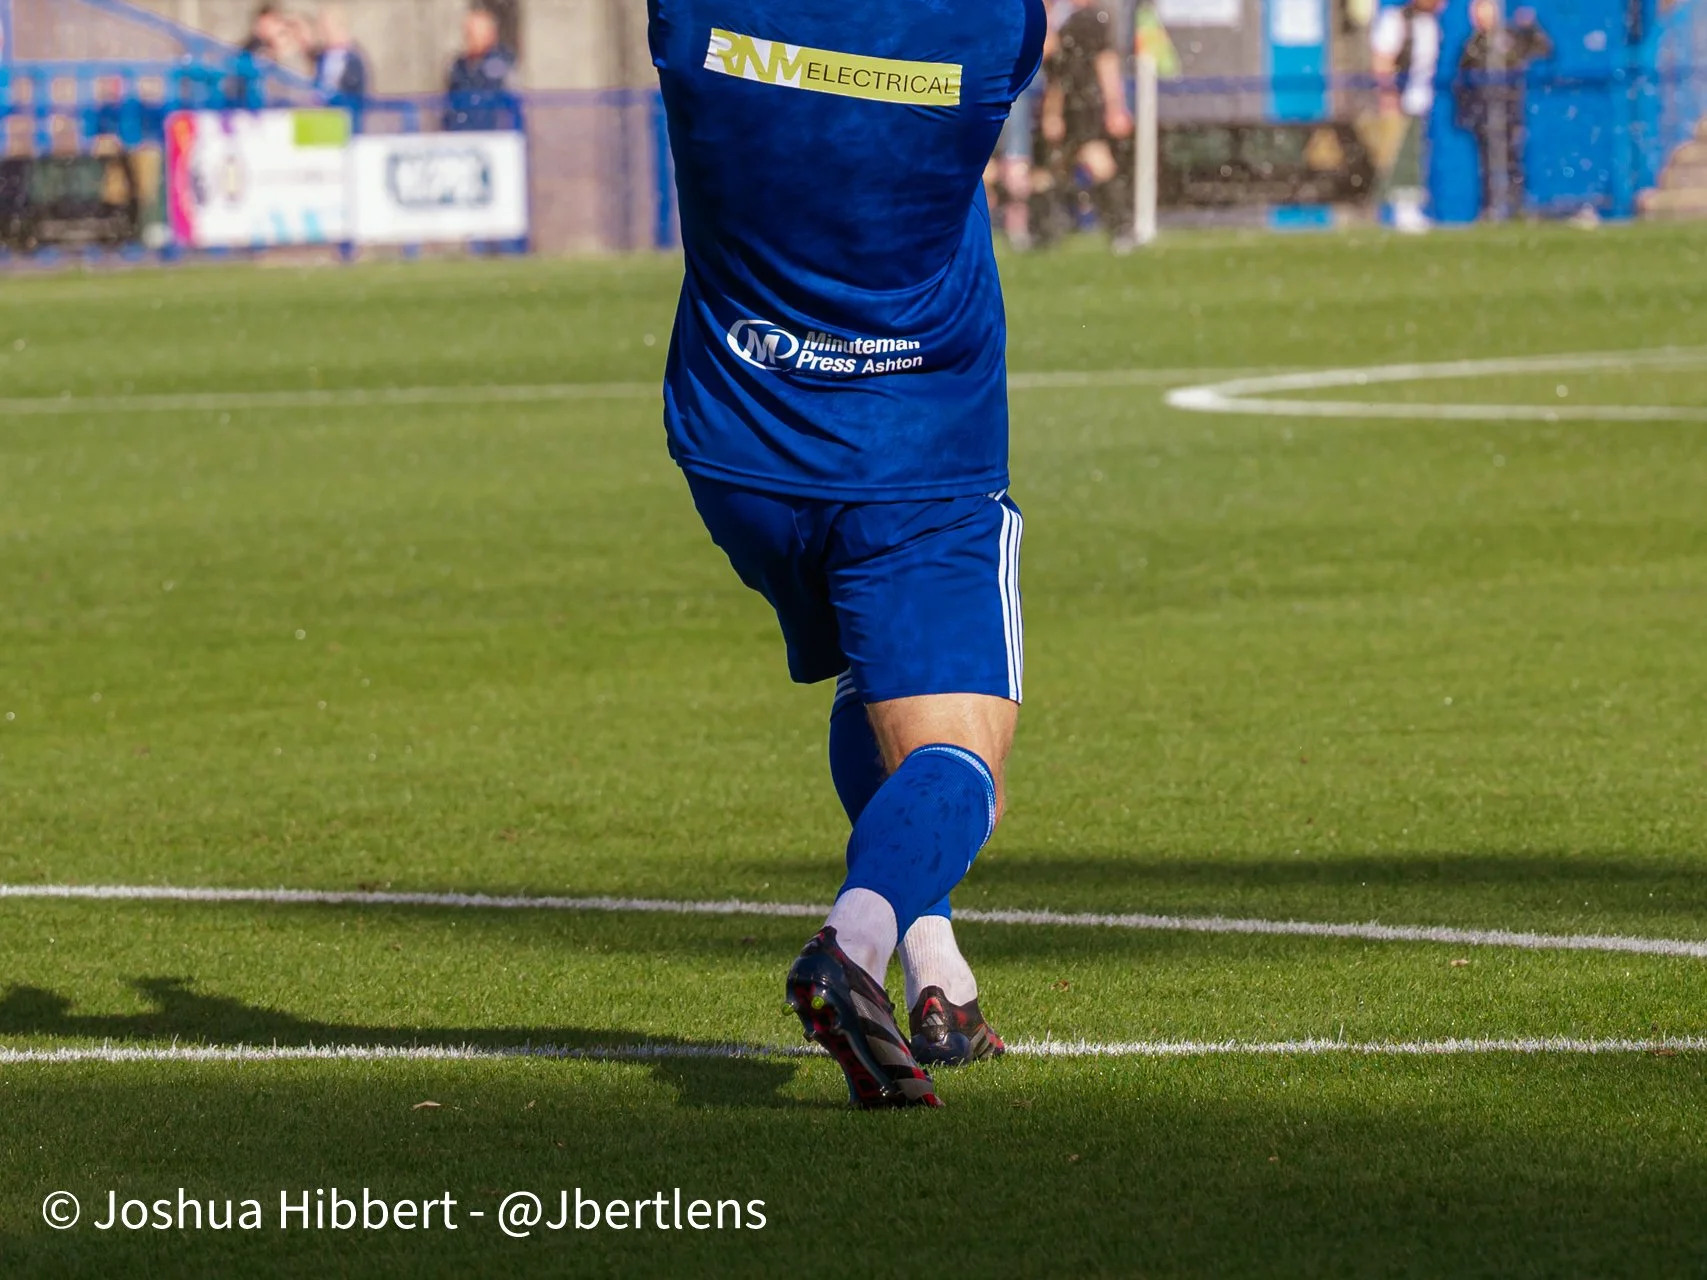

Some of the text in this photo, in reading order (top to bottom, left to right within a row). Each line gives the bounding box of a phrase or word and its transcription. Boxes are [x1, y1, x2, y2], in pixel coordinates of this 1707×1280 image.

[807, 62, 956, 95] ELECTRICAL
[803, 331, 921, 354] Minuteman
[796, 350, 923, 374] Press Ashton
